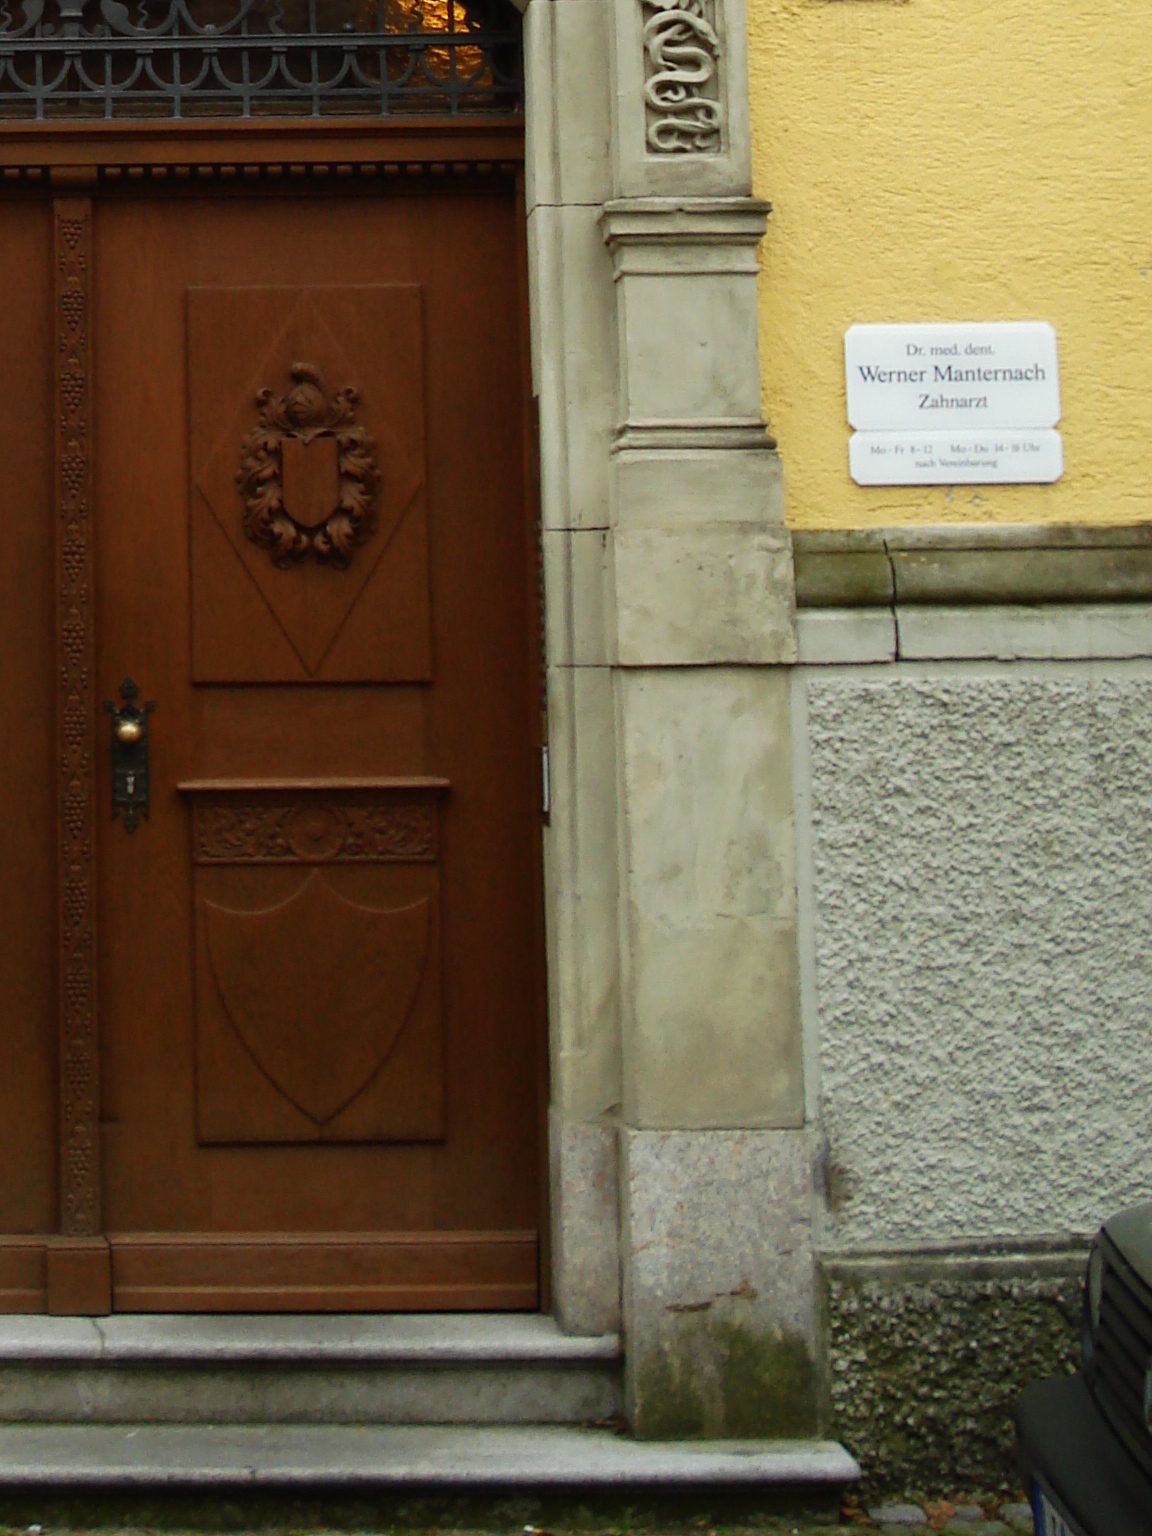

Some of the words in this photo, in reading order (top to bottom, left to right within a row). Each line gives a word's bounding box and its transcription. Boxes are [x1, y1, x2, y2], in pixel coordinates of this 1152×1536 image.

[906, 344, 926, 356] Dr.
[930, 344, 960, 356] med.
[964, 343, 995, 355] dent.
[858, 365, 927, 383] Werner
[933, 363, 1047, 383] Manternach
[918, 393, 988, 409] Zahnarzt
